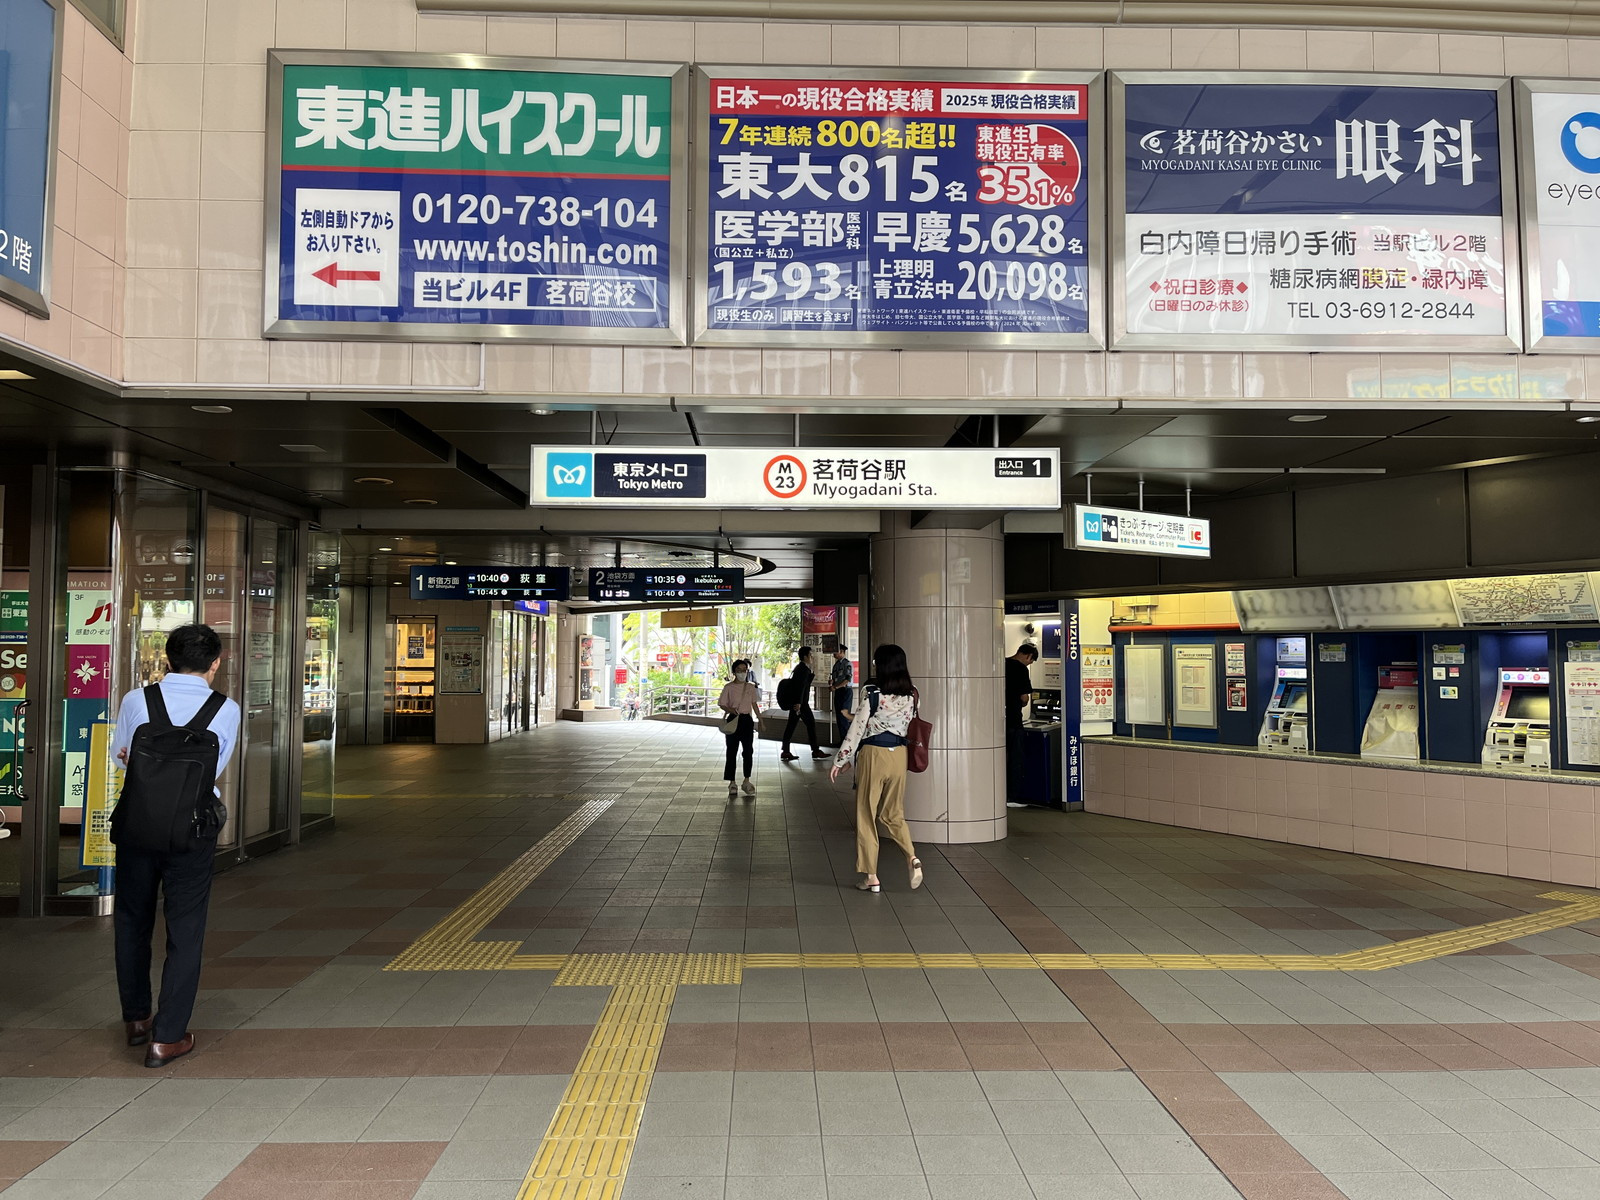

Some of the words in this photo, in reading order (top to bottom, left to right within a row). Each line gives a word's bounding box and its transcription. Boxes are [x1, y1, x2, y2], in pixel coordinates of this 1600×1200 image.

[716, 86, 934, 112] 日本一の現役合格実績
[946, 94, 989, 108] 2025年
[991, 94, 1076, 110] 現役合格実績
[295, 84, 662, 159] 東進ハイスクール
[718, 118, 812, 147] 7年連続
[817, 120, 956, 149] 800名超!!
[978, 126, 1030, 143] 東進生
[977, 143, 1064, 160] 現役占有率
[1172, 129, 1323, 155] 茗荷谷かさい
[1335, 118, 1482, 186] 眼科
[1141, 159, 1214, 171] MYOGADANI
[1218, 159, 1253, 171] KASAI
[1257, 159, 1278, 171] EYE
[1282, 159, 1322, 171] CLINIC
[717, 152, 968, 202] 東大815名
[979, 167, 1073, 203] 35.1%
[300, 208, 394, 230] 左側自動ドアから
[412, 193, 658, 229] 0120-738-104
[714, 210, 844, 247] 医学部
[847, 211, 861, 250] 医学科
[306, 233, 382, 253] お入り下さい。
[413, 235, 658, 266] www.toshin.com
[1139, 230, 1357, 256] 白内障日帰り手術
[1373, 233, 1486, 254] 当駅ビル2階
[872, 259, 934, 279] 上理明
[872, 279, 954, 300] 青立法中
[958, 260, 1084, 301] 20,098名
[1163, 278, 1236, 296] 祝日診療
[1270, 268, 1488, 291] 糖尿病網膜症・緑内障
[422, 279, 522, 304] 当ビル4F
[545, 280, 637, 307] 茗荷谷校
[1148, 299, 1250, 313] (日曜日のみ休診)
[1287, 302, 1319, 319] TEL
[1325, 302, 1475, 319] 03-6912-2844
[716, 309, 775, 322] 現役生のみ
[613, 462, 688, 477] 東京メトロ
[778, 463, 792, 474] M
[812, 459, 906, 481] 茗荷谷駅
[998, 460, 1023, 469] 出入口
[1031, 459, 1041, 476] 1
[617, 479, 649, 491] Tokyo
[651, 479, 684, 489] Metro
[775, 476, 796, 488] 23
[813, 482, 902, 499] Myogadani
[908, 483, 937, 496] Sta.
[66, 580, 107, 588] MATION
[415, 574, 423, 591] 1
[428, 576, 460, 585] 新宿方面
[476, 574, 499, 582] 10:40
[595, 570, 605, 585] 2
[607, 572, 636, 580] 池袋方面
[653, 575, 676, 583] 10:35
[1069, 612, 1079, 660] MIZUHO
[1069, 735, 1079, 787] みずほ銀行
